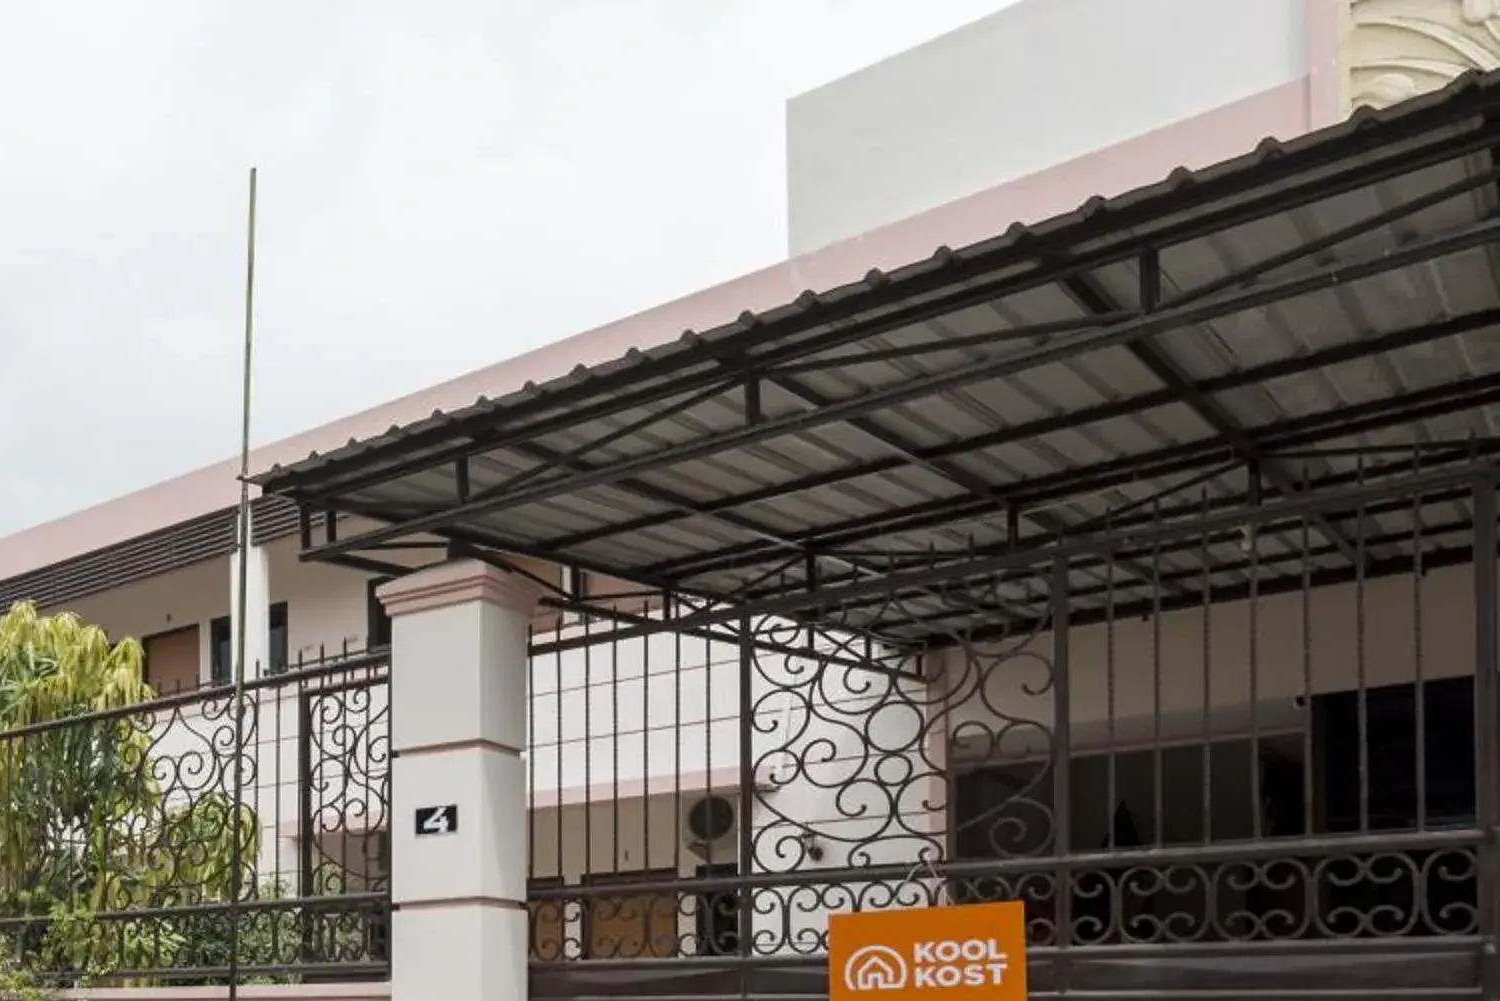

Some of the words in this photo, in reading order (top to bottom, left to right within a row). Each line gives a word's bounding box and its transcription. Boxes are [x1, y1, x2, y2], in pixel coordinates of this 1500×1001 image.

[423, 806, 449, 833] 4
[913, 938, 1008, 963] KOOL
[914, 963, 1008, 988] KOST
